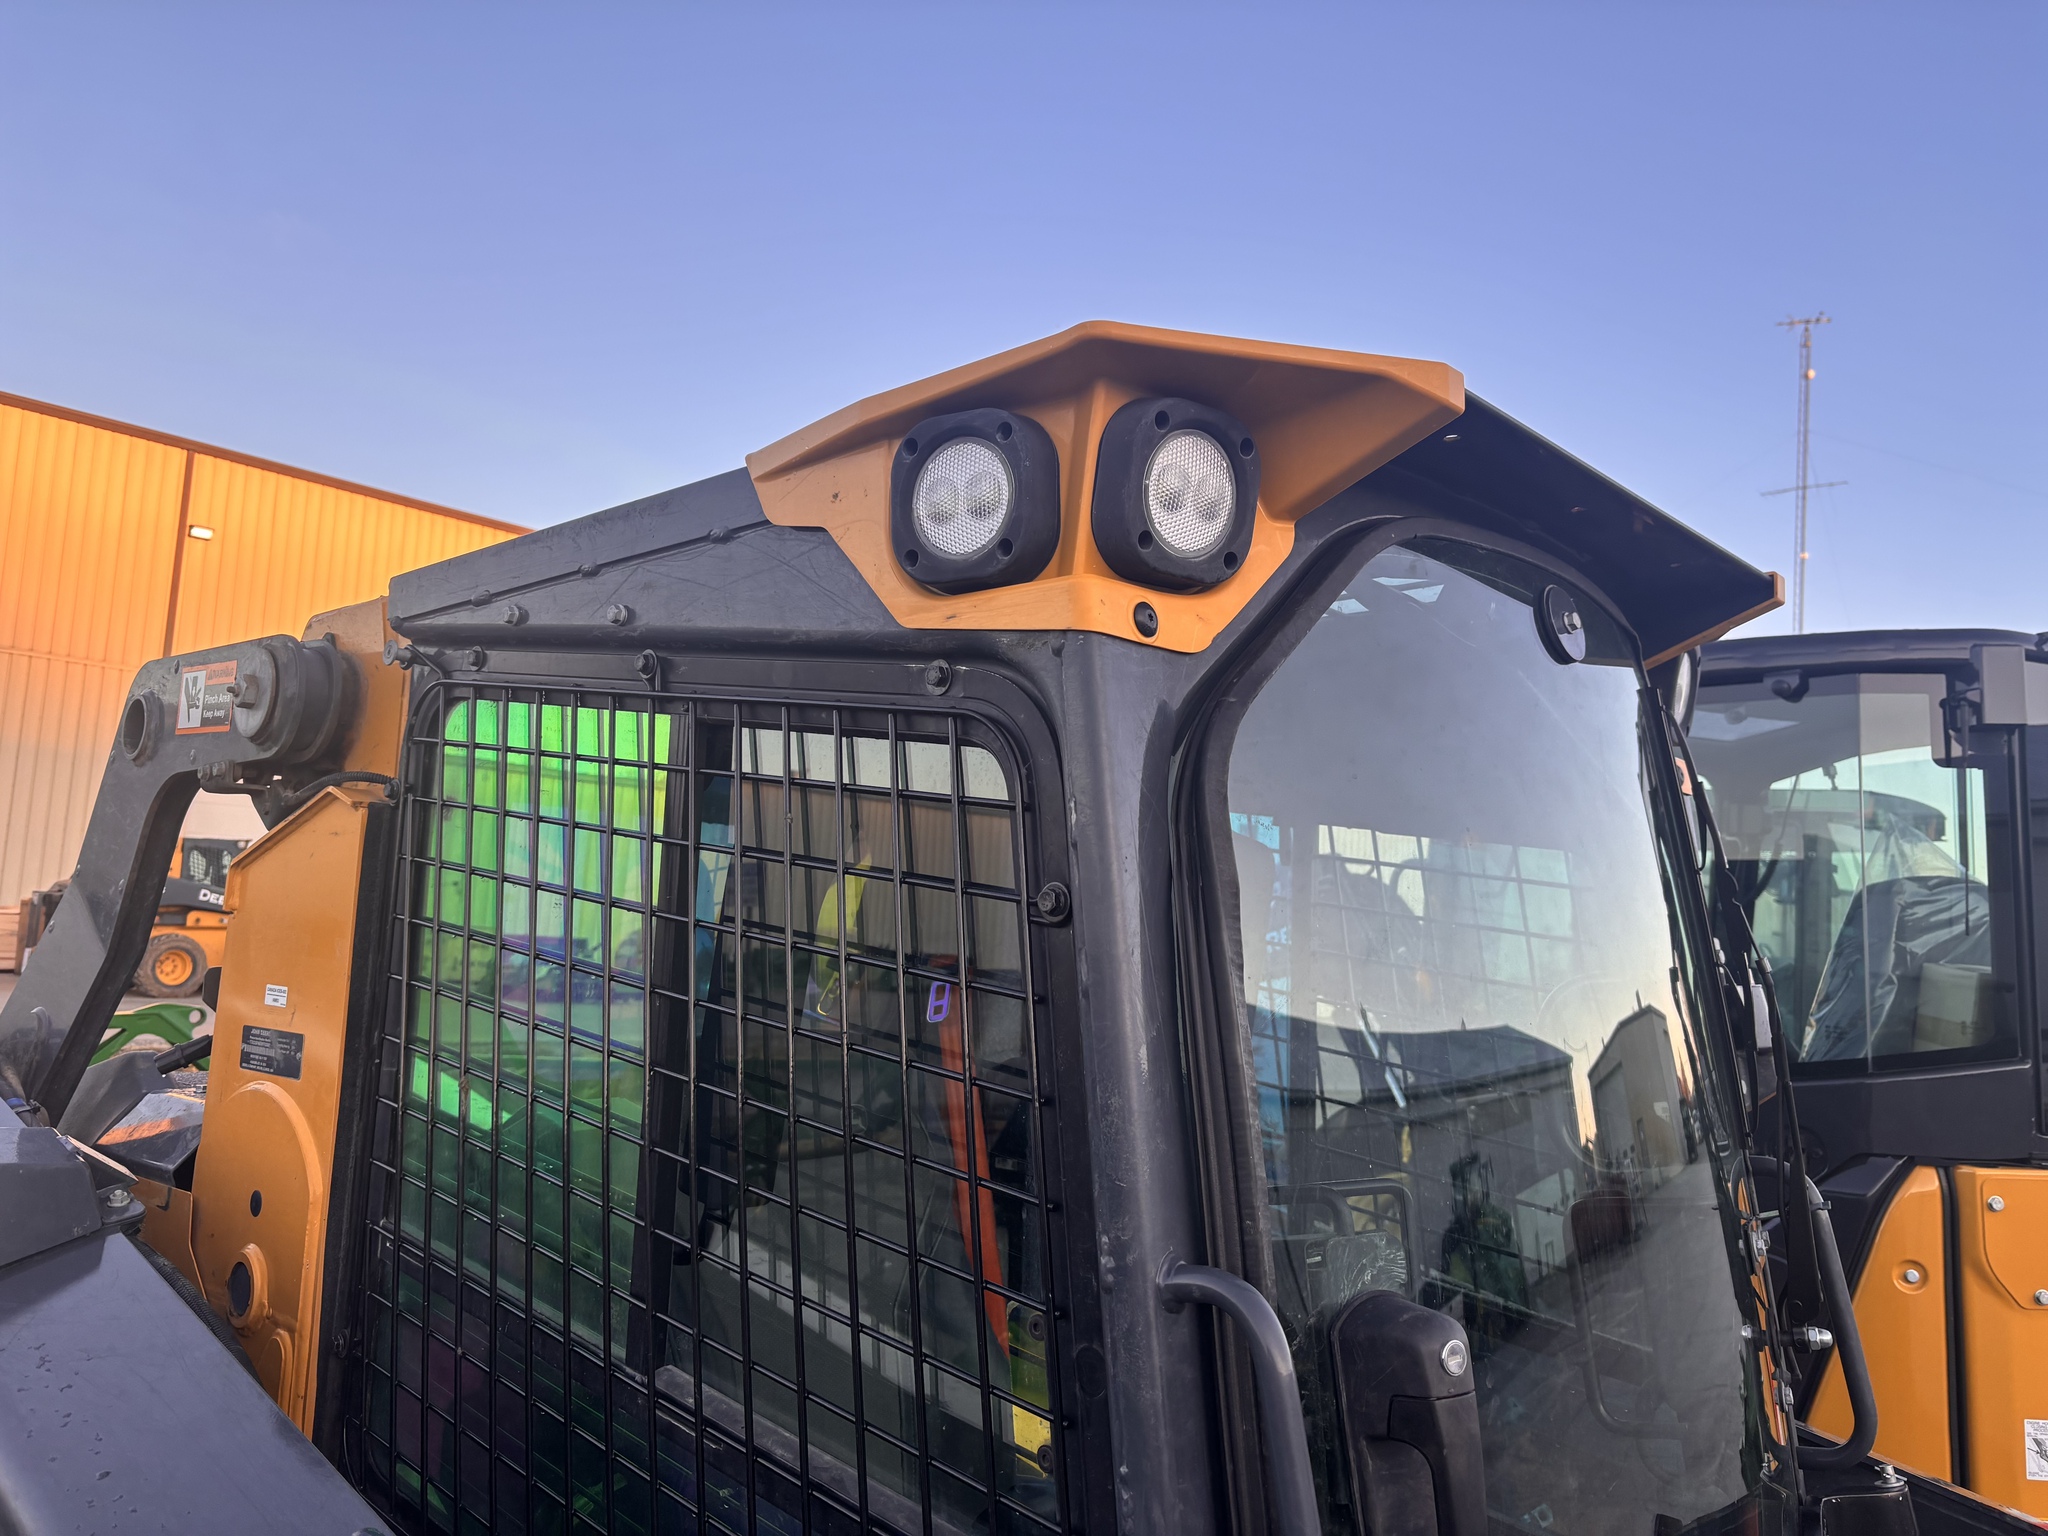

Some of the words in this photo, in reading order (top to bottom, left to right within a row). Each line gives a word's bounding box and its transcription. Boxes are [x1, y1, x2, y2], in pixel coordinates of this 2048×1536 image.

[204, 694, 218, 704] Pinch
[218, 693, 231, 703] Area
[202, 710, 214, 720] Keep
[214, 709, 226, 719] Away
